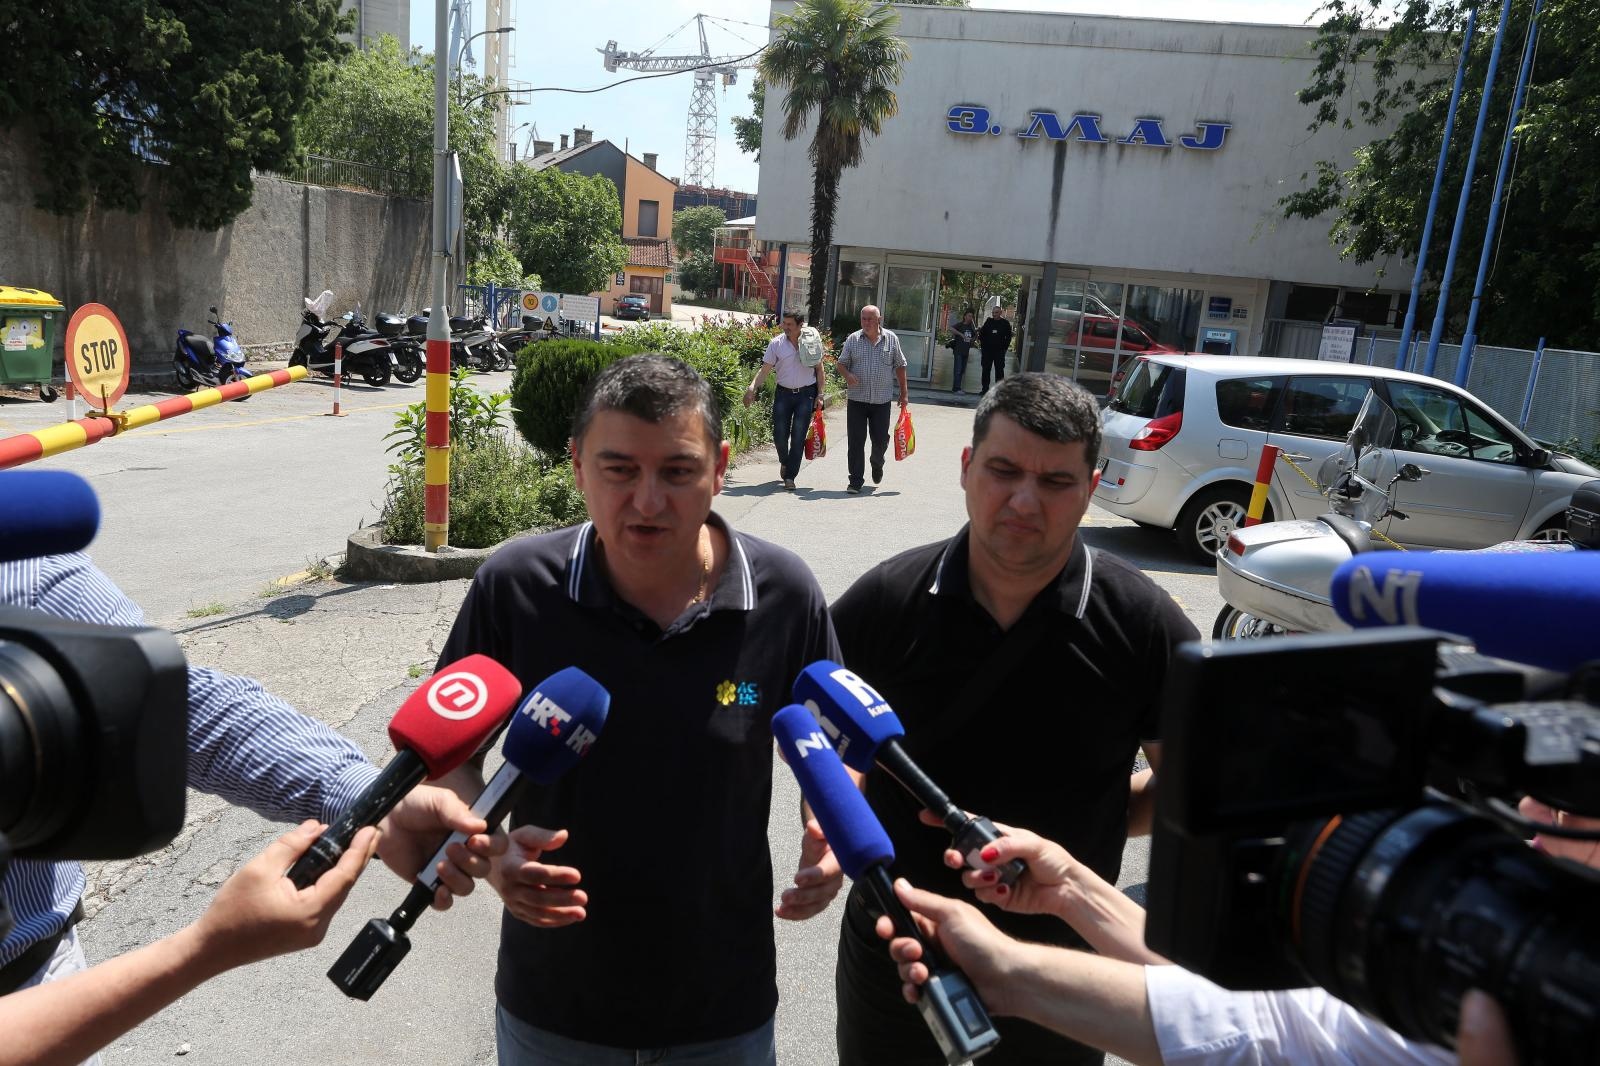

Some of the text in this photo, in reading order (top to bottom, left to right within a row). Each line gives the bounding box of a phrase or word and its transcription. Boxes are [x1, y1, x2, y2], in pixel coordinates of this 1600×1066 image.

[947, 105, 1002, 136] 3.
[81, 339, 118, 374] STOP
[522, 691, 572, 729] HRT
[795, 732, 832, 758] N1
